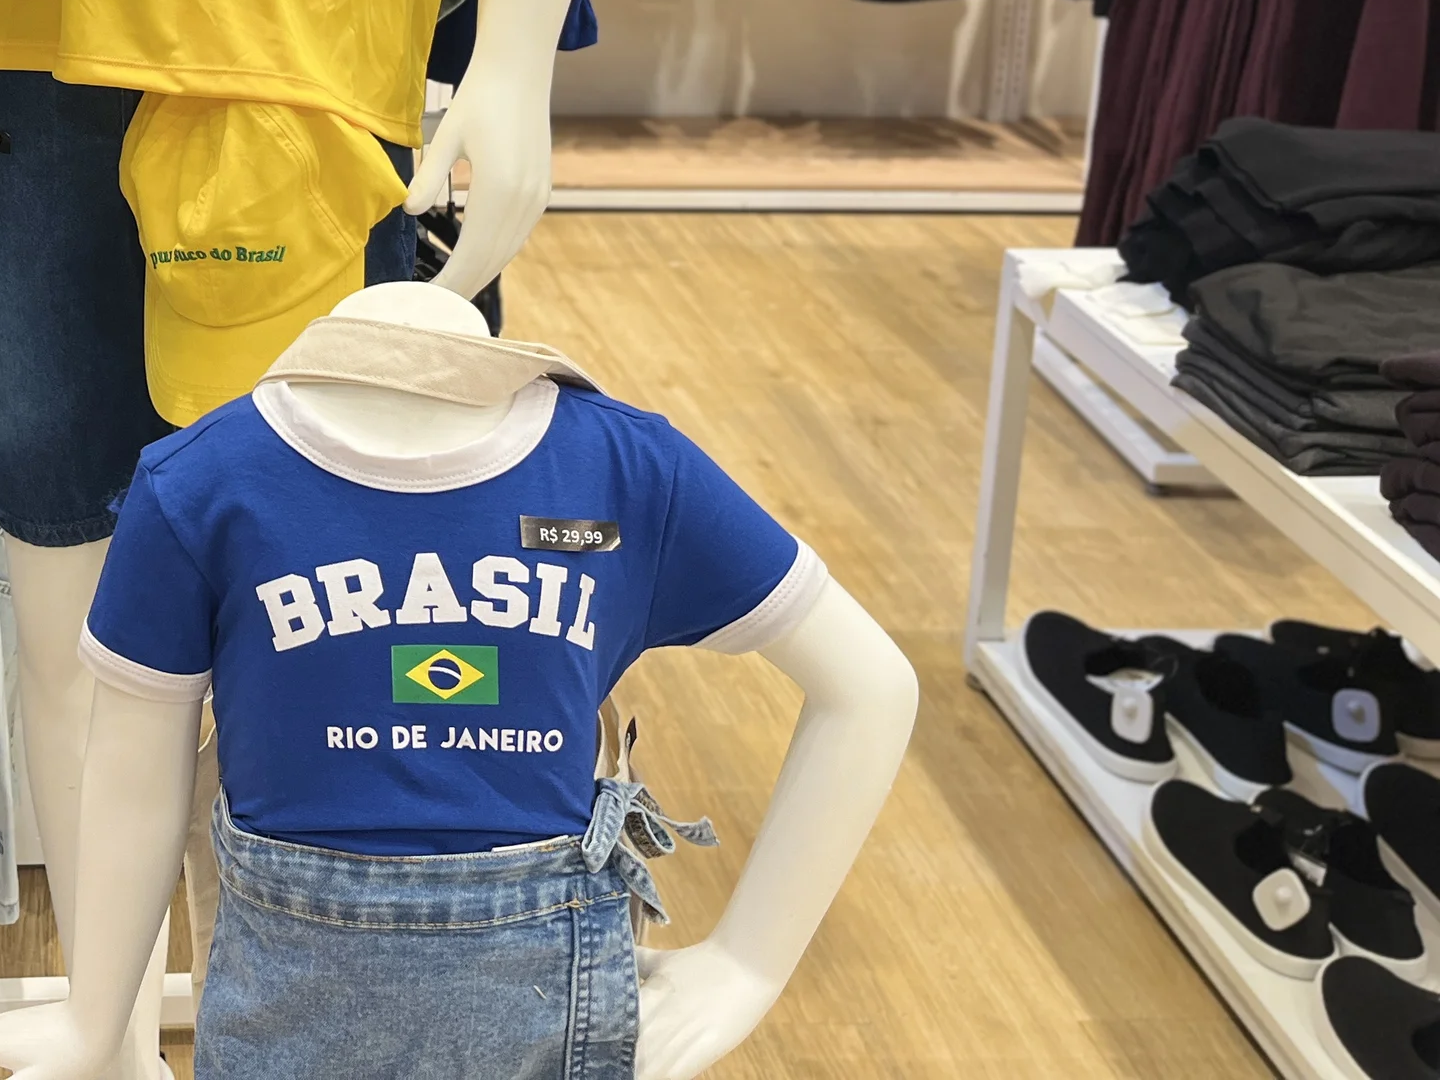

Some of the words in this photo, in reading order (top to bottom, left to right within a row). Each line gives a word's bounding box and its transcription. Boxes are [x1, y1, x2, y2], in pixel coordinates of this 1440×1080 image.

[210, 248, 232, 261] do
[235, 245, 286, 262] Brasil
[540, 527, 558, 544] R$
[561, 529, 603, 546] 29,99
[255, 552, 595, 652] BRASIL
[326, 726, 378, 749] RIO
[392, 725, 427, 749] DE
[440, 726, 564, 752] JANEIRO
